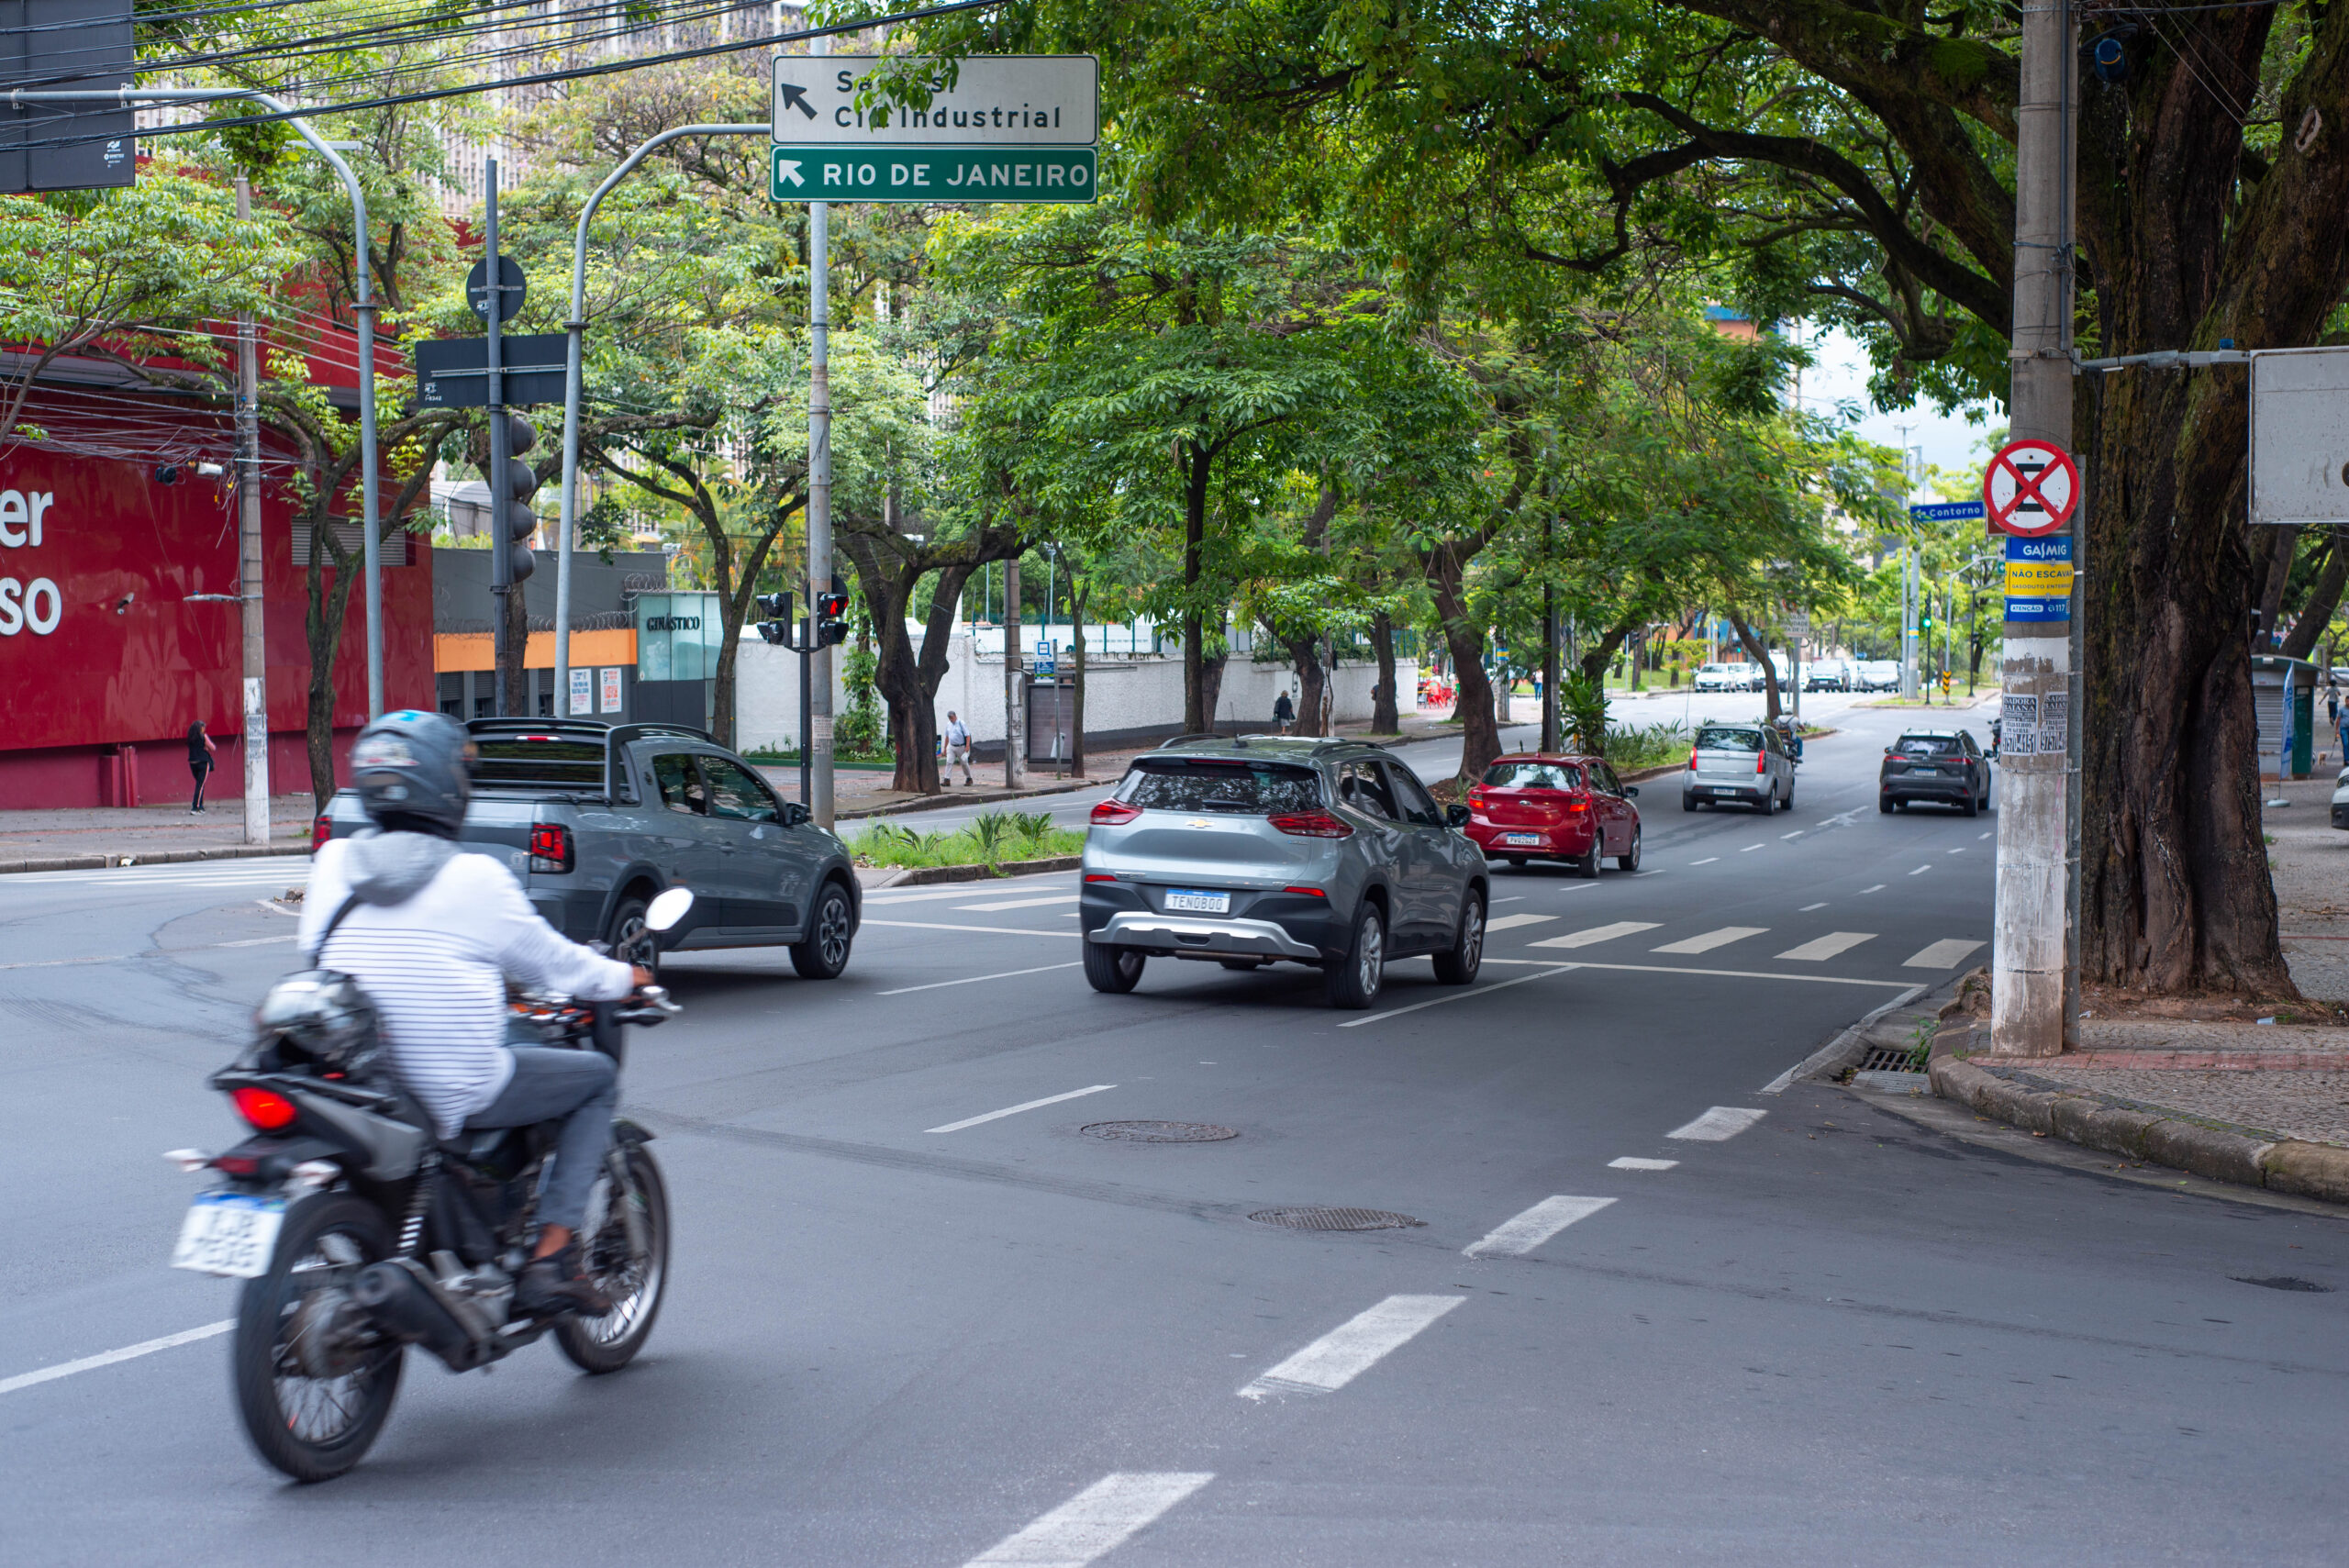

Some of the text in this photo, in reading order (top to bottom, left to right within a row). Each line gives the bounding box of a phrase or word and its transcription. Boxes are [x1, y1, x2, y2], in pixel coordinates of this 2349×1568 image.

[901, 103, 1060, 128] Industrial
[824, 163, 1088, 187] RIO DE JANEIRO
[0, 489, 53, 548] er
[1930, 506, 1980, 517] Contorno
[2023, 543, 2066, 558] GASMIG
[2012, 569, 2033, 578] NÃO
[0, 577, 62, 636] so
[2055, 604, 2065, 612] 117
[647, 614, 700, 632] GINÁSTICO
